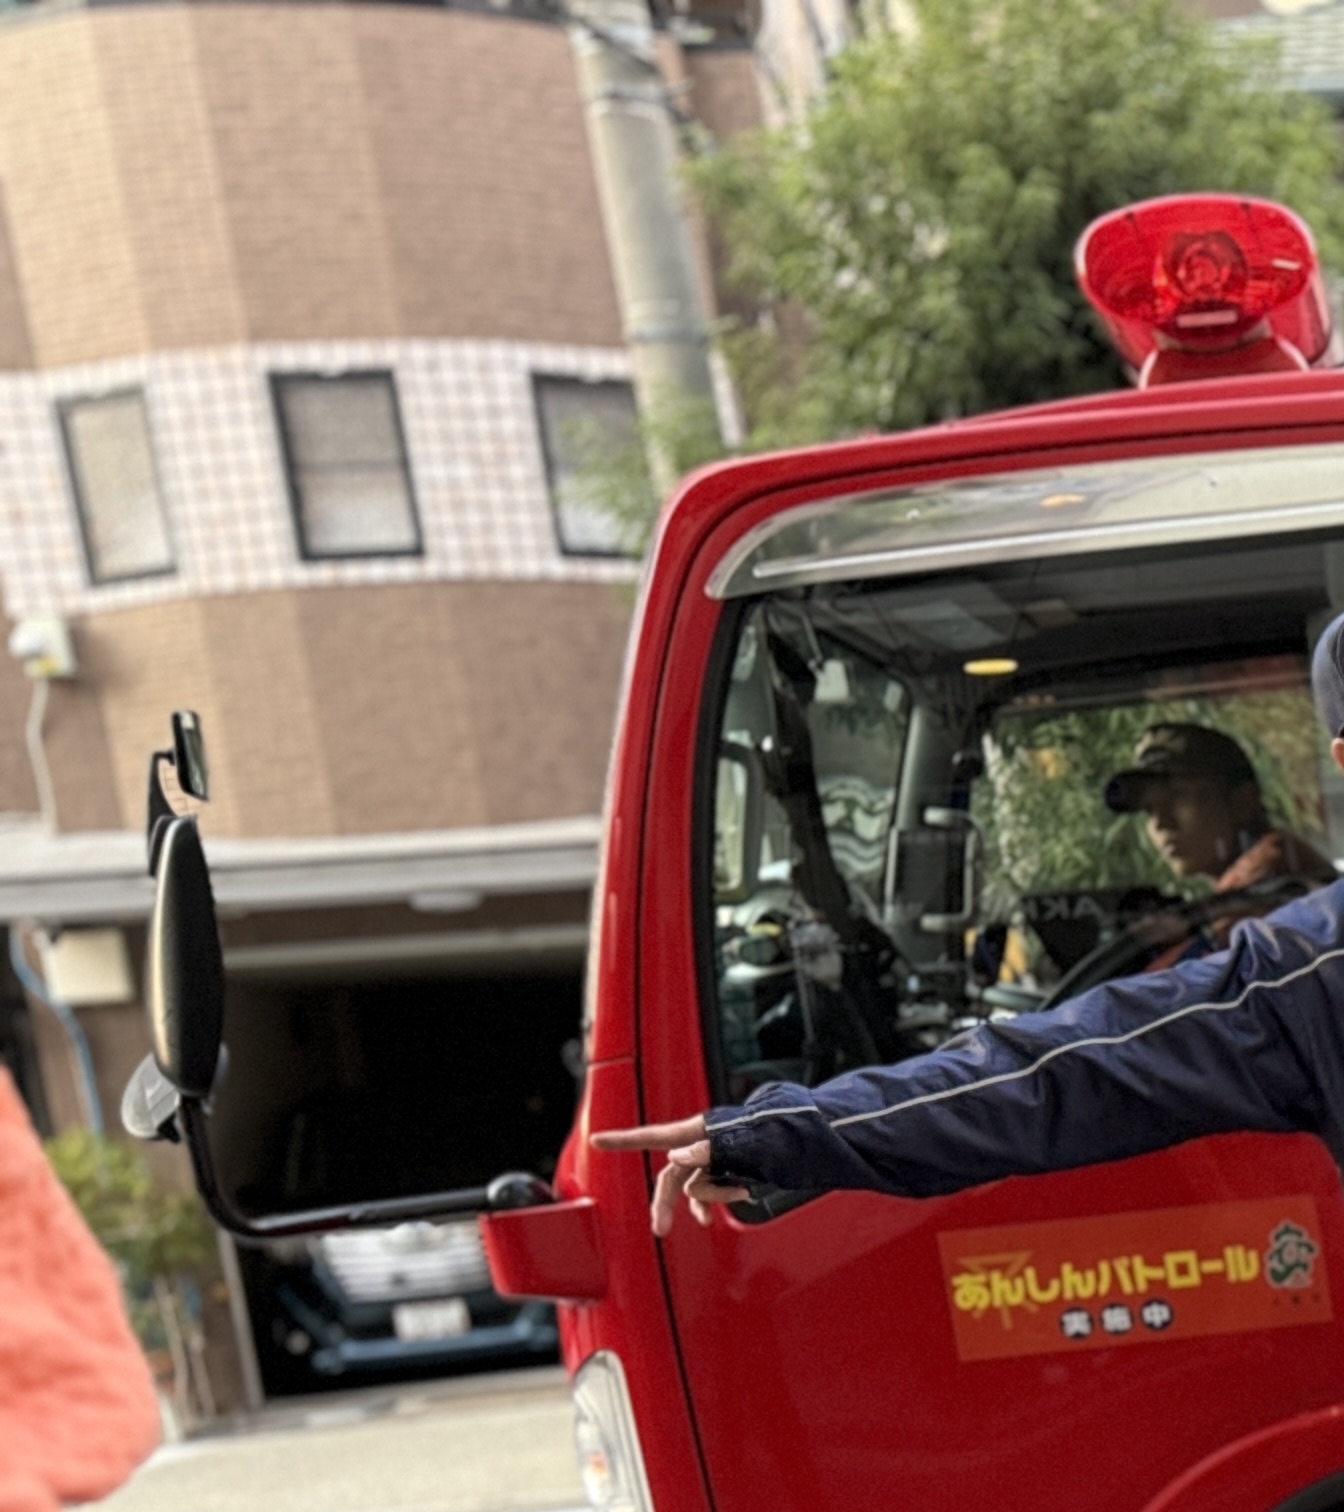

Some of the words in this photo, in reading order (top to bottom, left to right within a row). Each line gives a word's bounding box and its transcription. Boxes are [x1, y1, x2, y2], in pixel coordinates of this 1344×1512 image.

[952, 1245, 1259, 1311] あんしんパトロール
